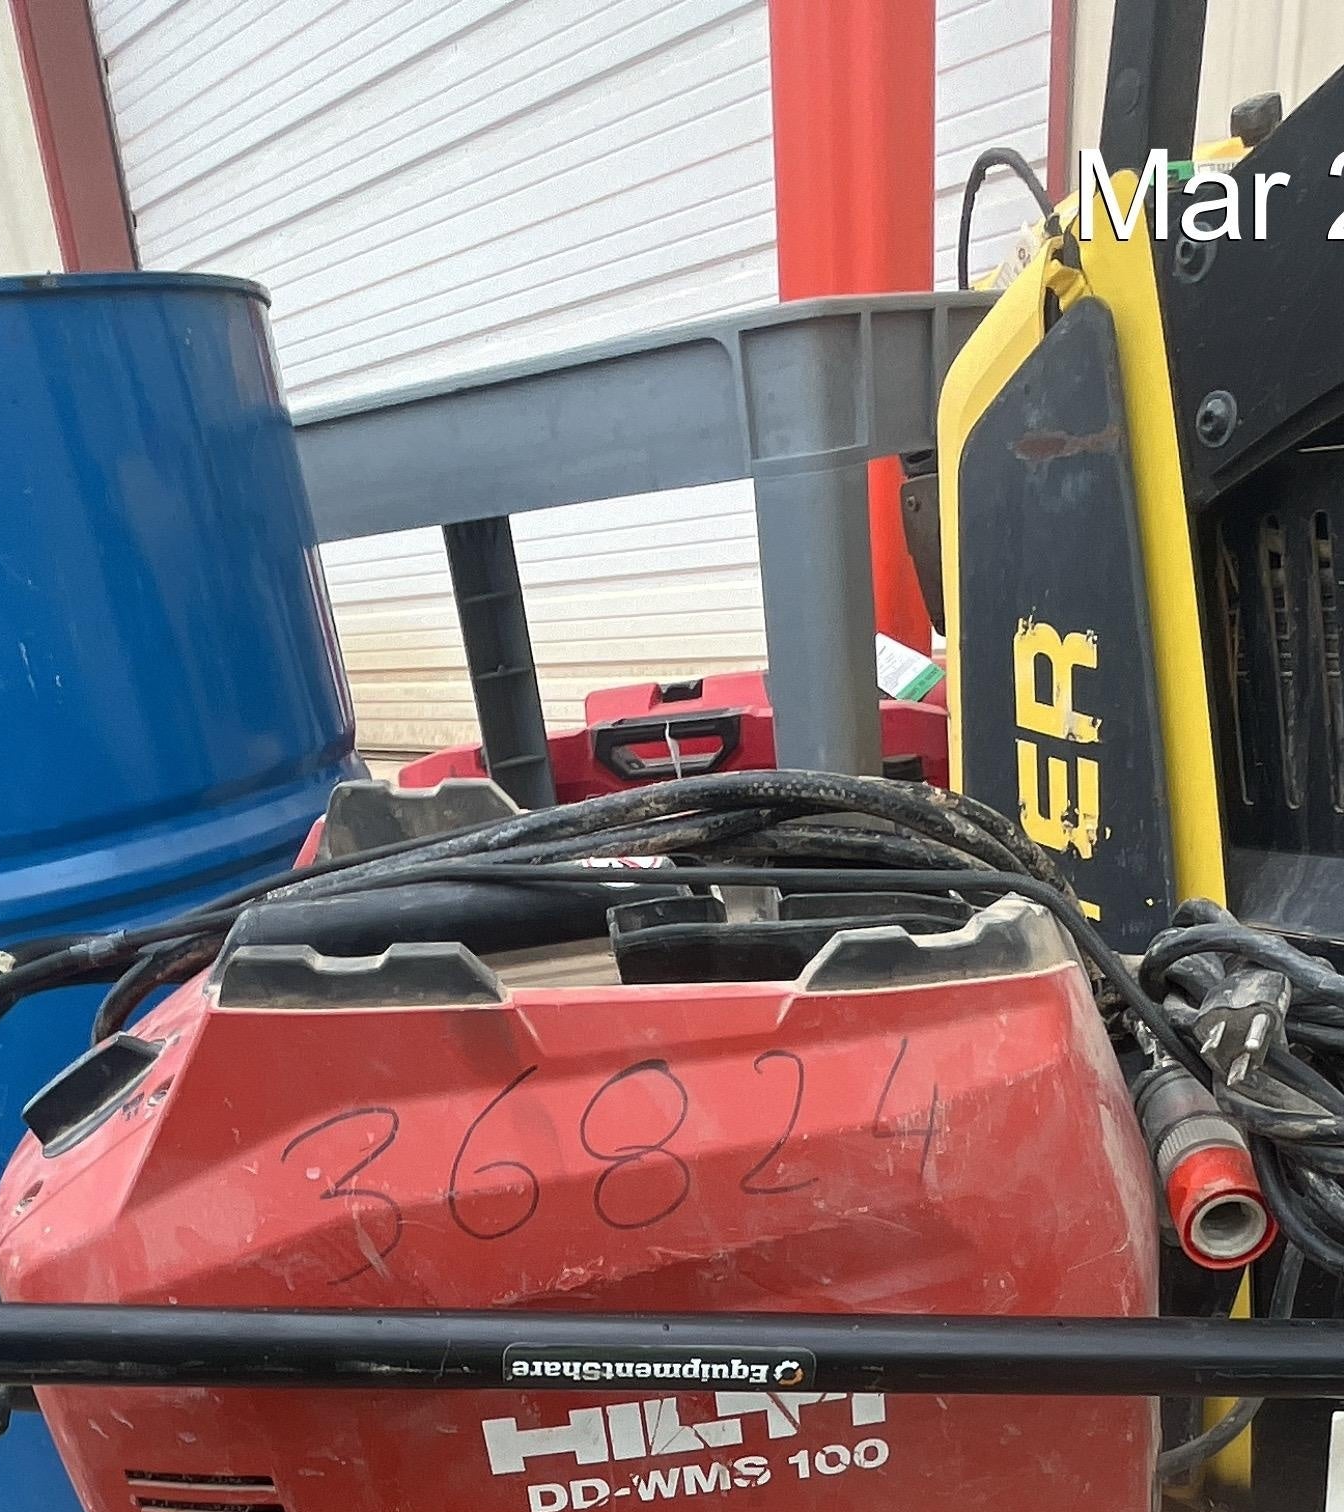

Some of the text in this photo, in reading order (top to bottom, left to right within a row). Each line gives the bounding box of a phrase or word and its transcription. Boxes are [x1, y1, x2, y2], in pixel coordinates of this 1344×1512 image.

[280, 1036, 941, 1286] 36824
[511, 1360, 769, 1384] EquipmentShare
[787, 1438, 890, 1480] 100
